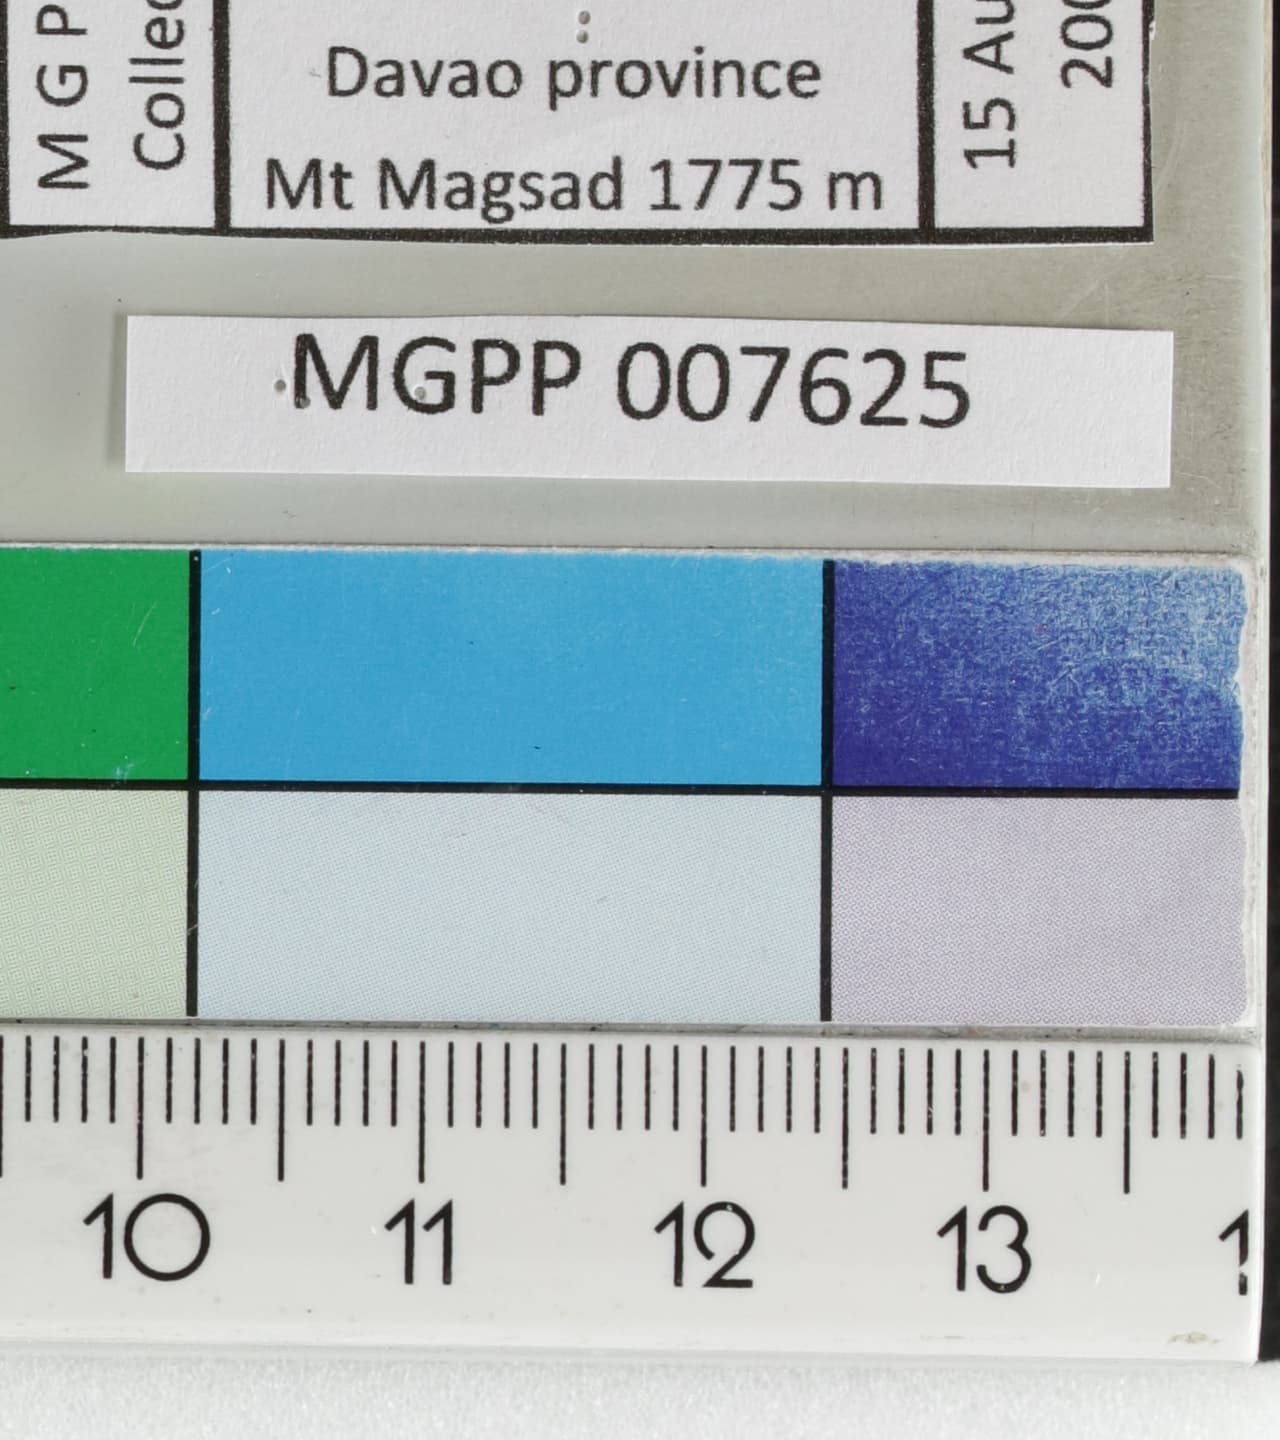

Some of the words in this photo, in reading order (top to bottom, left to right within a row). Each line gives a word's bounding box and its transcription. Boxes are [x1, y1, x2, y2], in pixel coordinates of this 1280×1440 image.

[36, 4, 87, 36] P
[36, 65, 88, 107] G
[328, 46, 523, 98] Davao
[548, 46, 821, 112] province
[37, 134, 90, 189] M
[962, 97, 1016, 169] 15
[267, 158, 353, 210] Mt
[379, 155, 623, 224] Magsad
[650, 158, 803, 211] 1775
[828, 172, 882, 210] m
[294, 333, 581, 416] MGPP
[617, 342, 970, 429] 007625
[83, 1193, 211, 1282] 10
[384, 1199, 453, 1285] 11
[654, 1201, 755, 1288] 12
[937, 1205, 1032, 1294] 13
